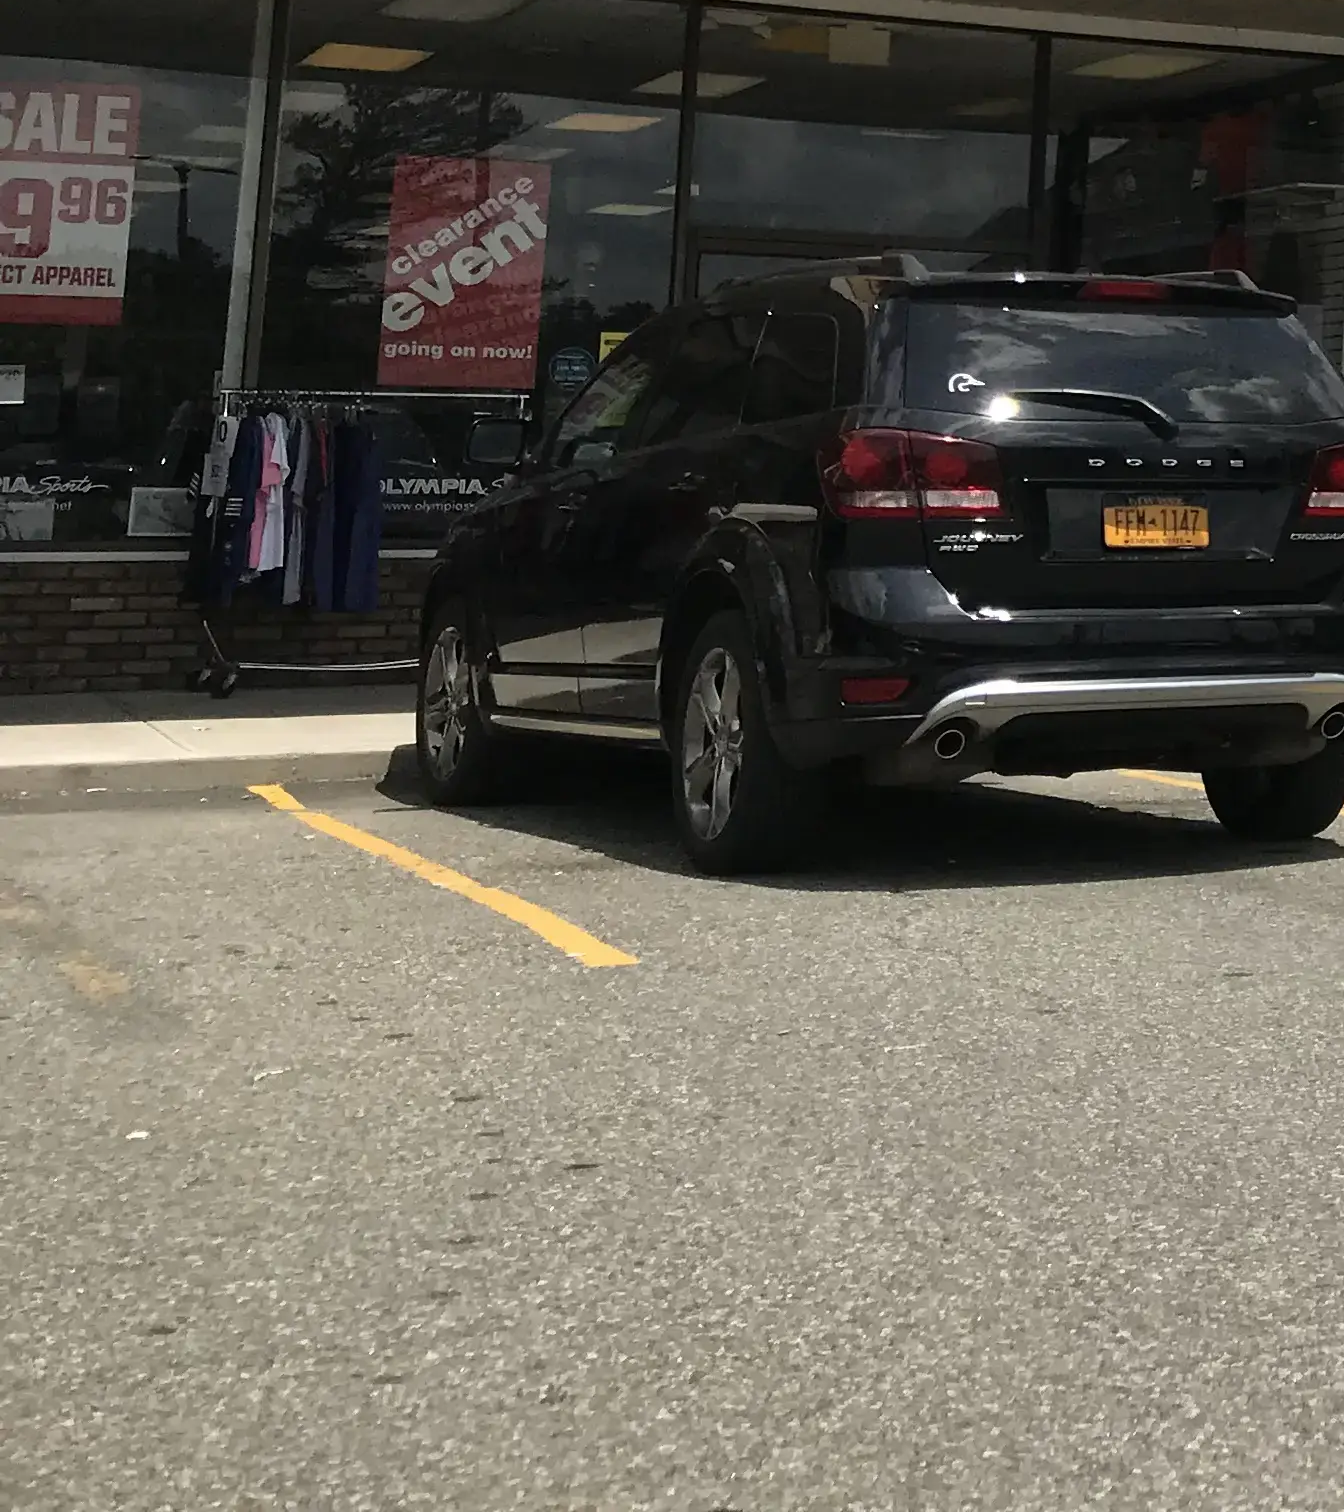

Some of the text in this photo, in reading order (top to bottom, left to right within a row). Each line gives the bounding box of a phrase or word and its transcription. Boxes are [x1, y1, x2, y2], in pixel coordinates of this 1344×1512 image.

[391, 177, 534, 275] clearance
[381, 197, 547, 332] event
[0, 264, 116, 287] CT APPAREL
[384, 341, 532, 359] going on now!
[1088, 458, 1244, 468] DODGE
[0, 476, 29, 494] IA
[933, 534, 1024, 543] JOUNEY
